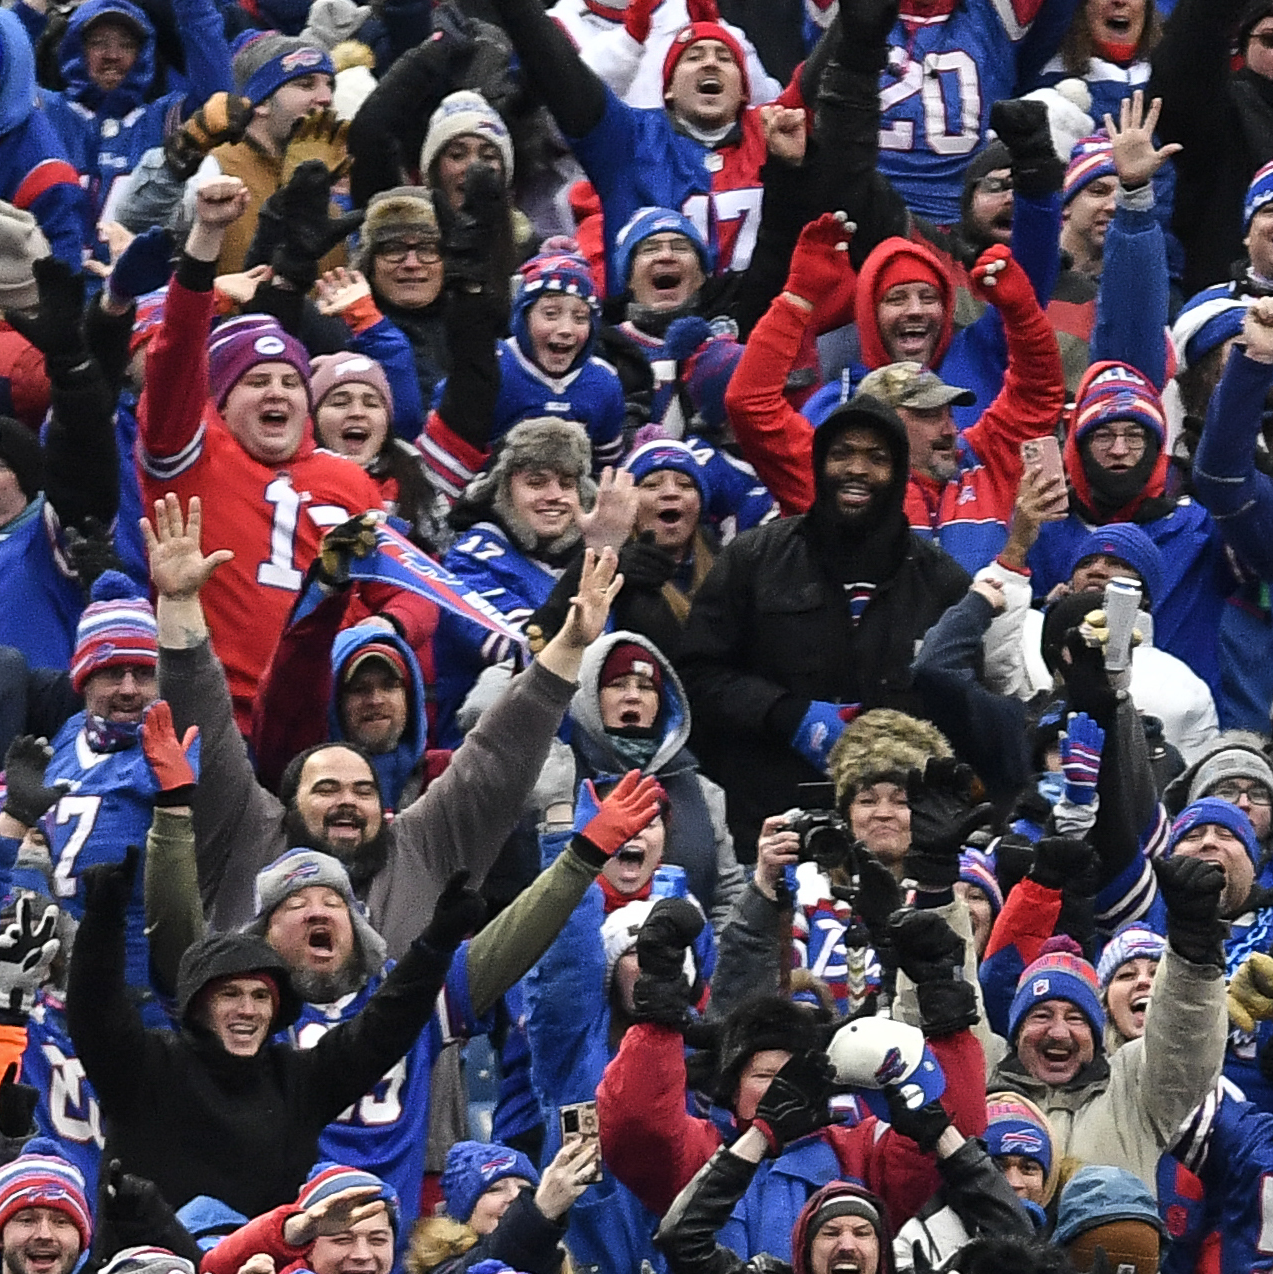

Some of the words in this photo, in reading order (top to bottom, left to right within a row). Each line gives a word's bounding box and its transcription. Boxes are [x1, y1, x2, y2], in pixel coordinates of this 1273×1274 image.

[878, 48, 982, 155] 20
[681, 185, 766, 275] 17
[456, 534, 507, 561] 17
[56, 795, 111, 898] 7
